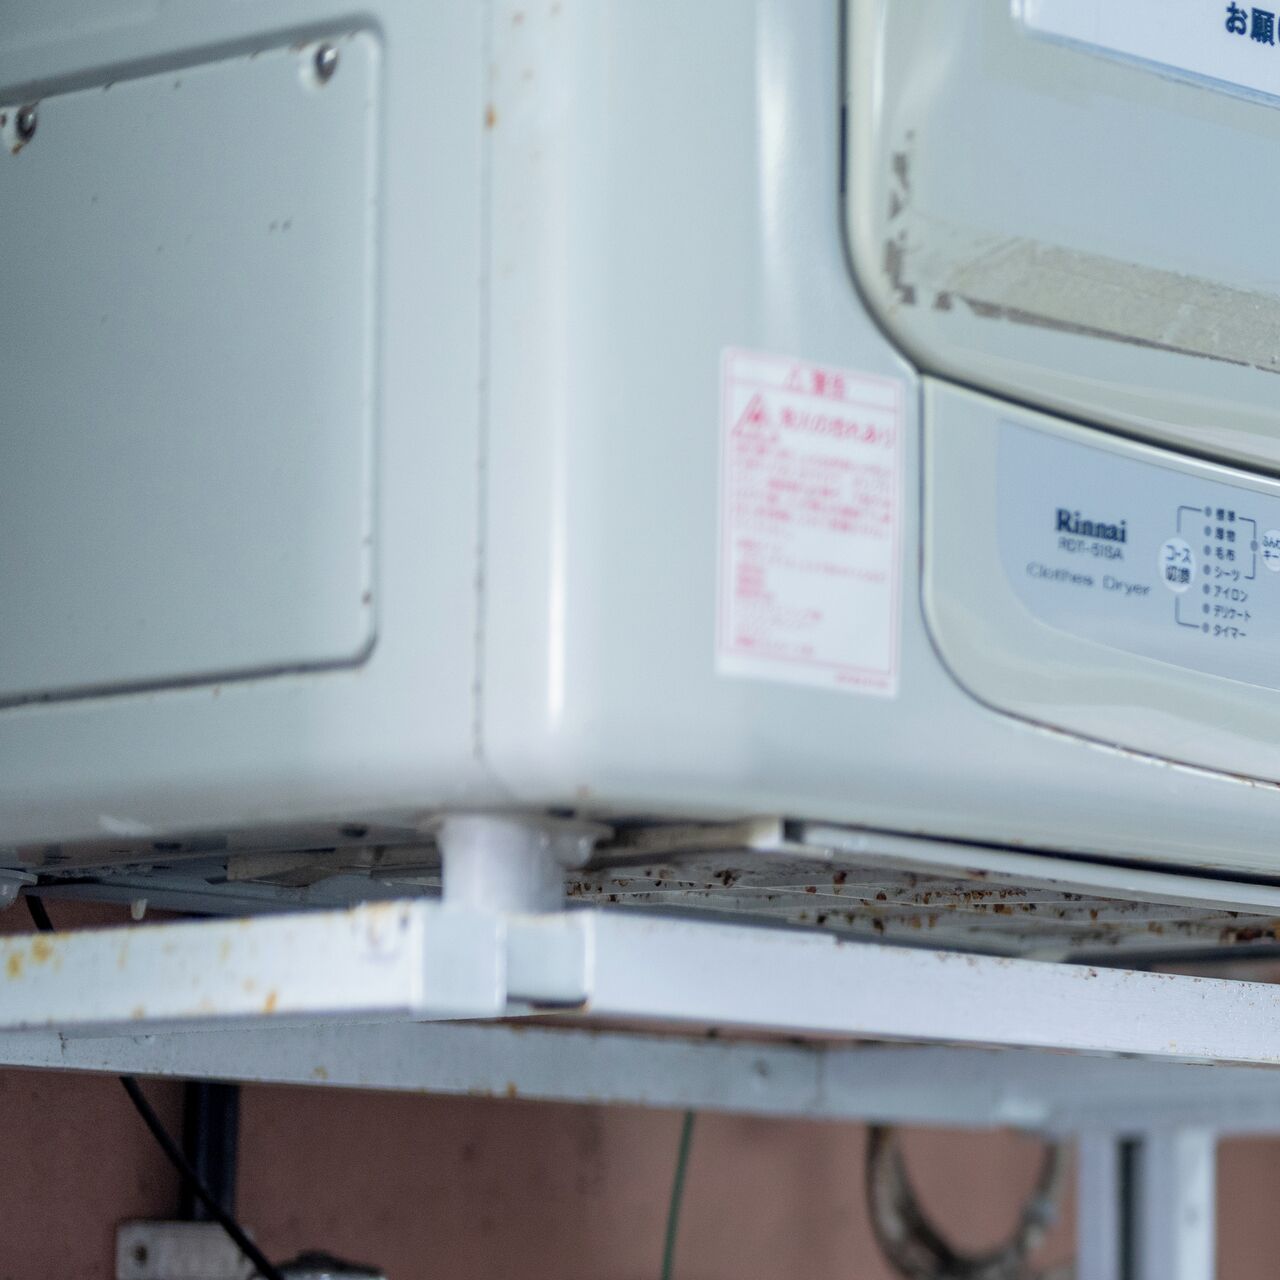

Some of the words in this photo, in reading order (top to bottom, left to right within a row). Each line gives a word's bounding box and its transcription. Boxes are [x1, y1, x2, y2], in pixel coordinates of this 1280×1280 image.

[1056, 507, 1127, 543] Rinnai
[1026, 561, 1094, 586] Clothes
[1102, 575, 1150, 596] Dryer
[1214, 585, 1248, 602] アイロン
